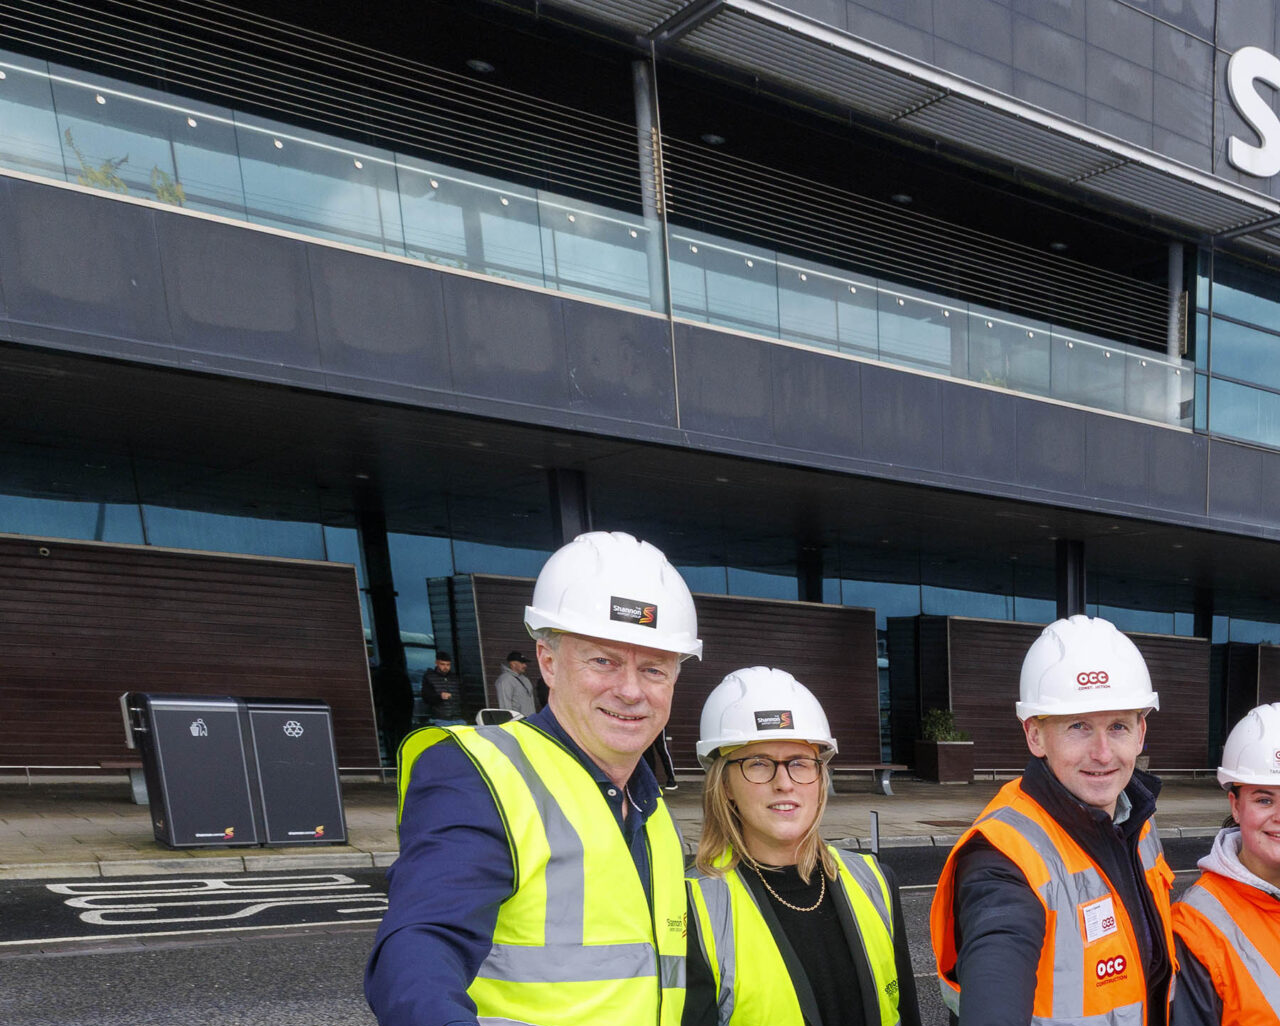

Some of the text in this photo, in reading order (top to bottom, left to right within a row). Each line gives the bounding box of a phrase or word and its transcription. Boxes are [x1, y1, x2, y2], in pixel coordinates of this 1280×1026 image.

[613, 605, 642, 616] Shannon
[1077, 671, 1109, 686] OCC
[1097, 957, 1126, 977] OCC
